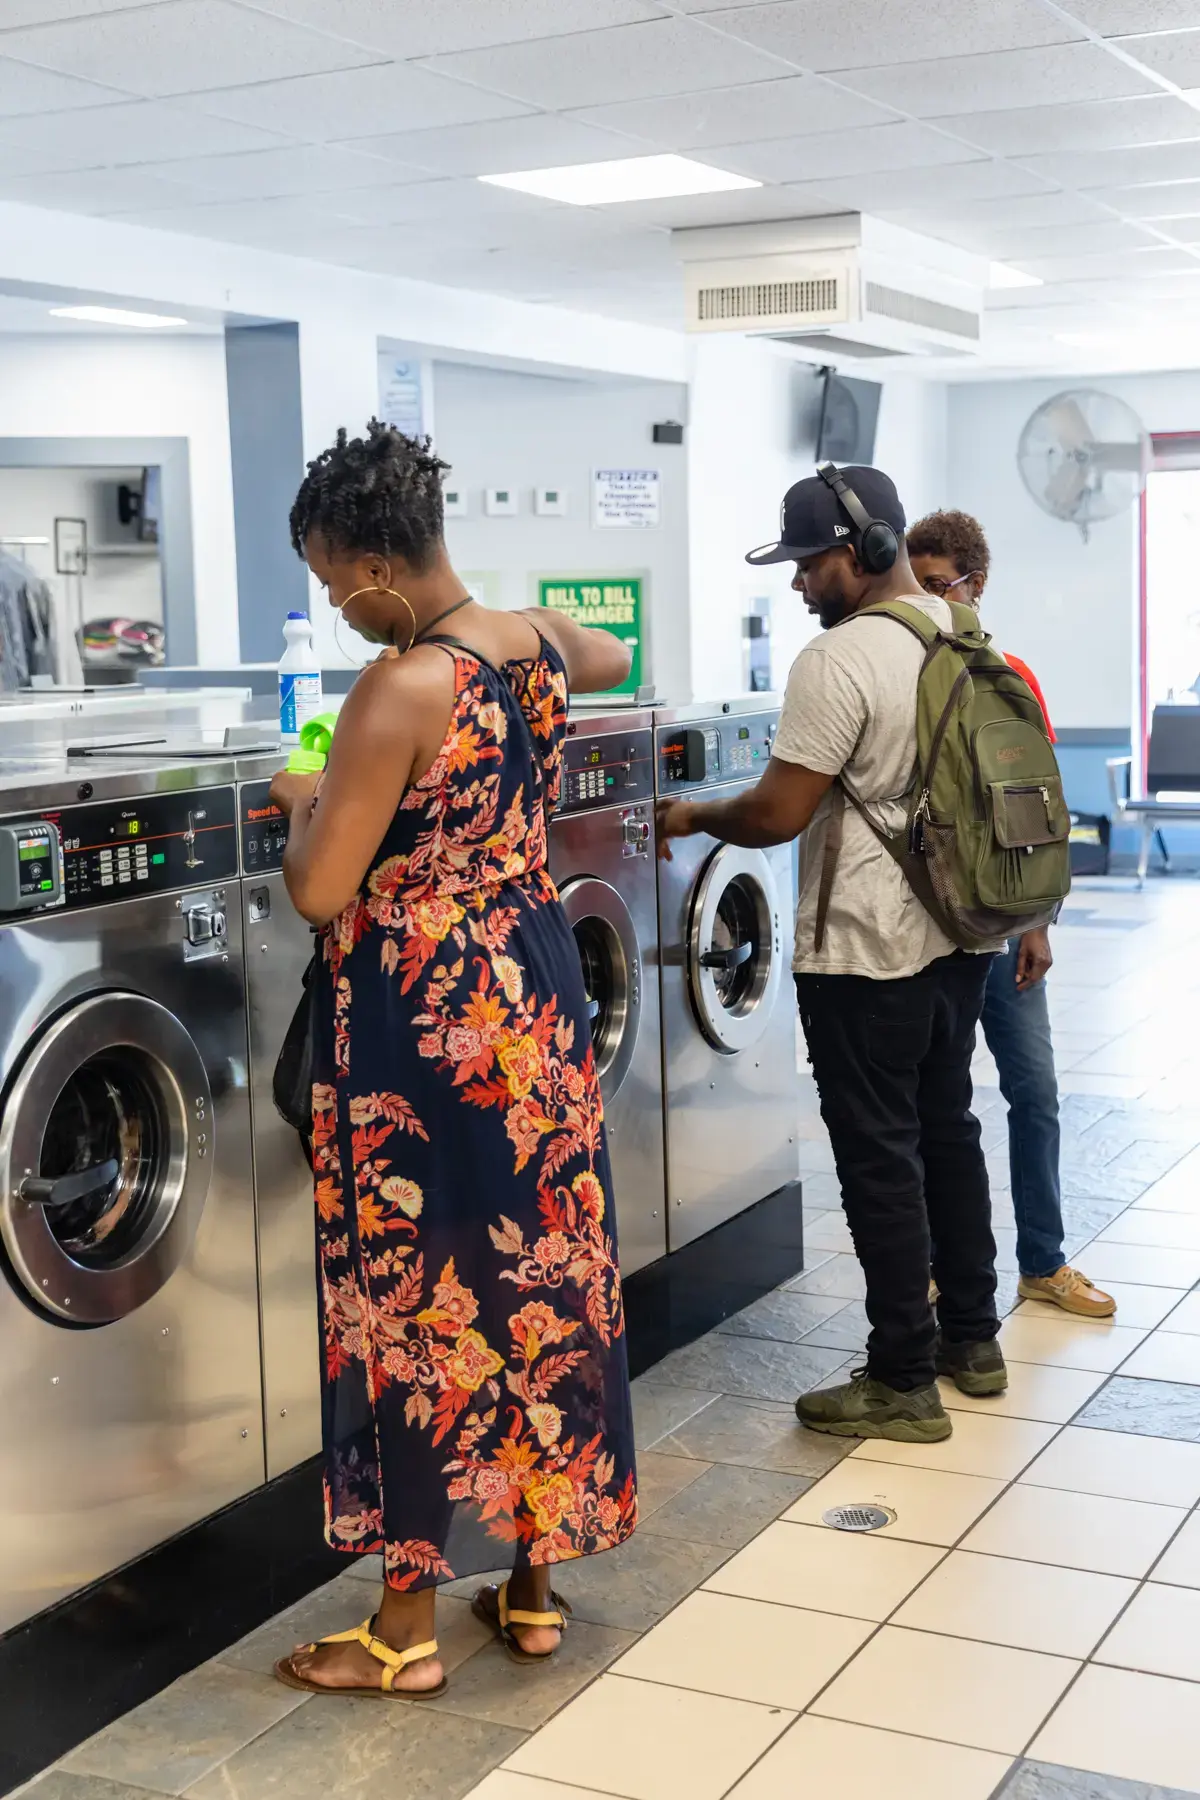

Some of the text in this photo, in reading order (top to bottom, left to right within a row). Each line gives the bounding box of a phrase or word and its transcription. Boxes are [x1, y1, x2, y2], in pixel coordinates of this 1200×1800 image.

[546, 586, 636, 606] BILL TO BILL
[247, 806, 270, 819] Speed
[128, 821, 138, 834] 18
[257, 897, 263, 910] 8
